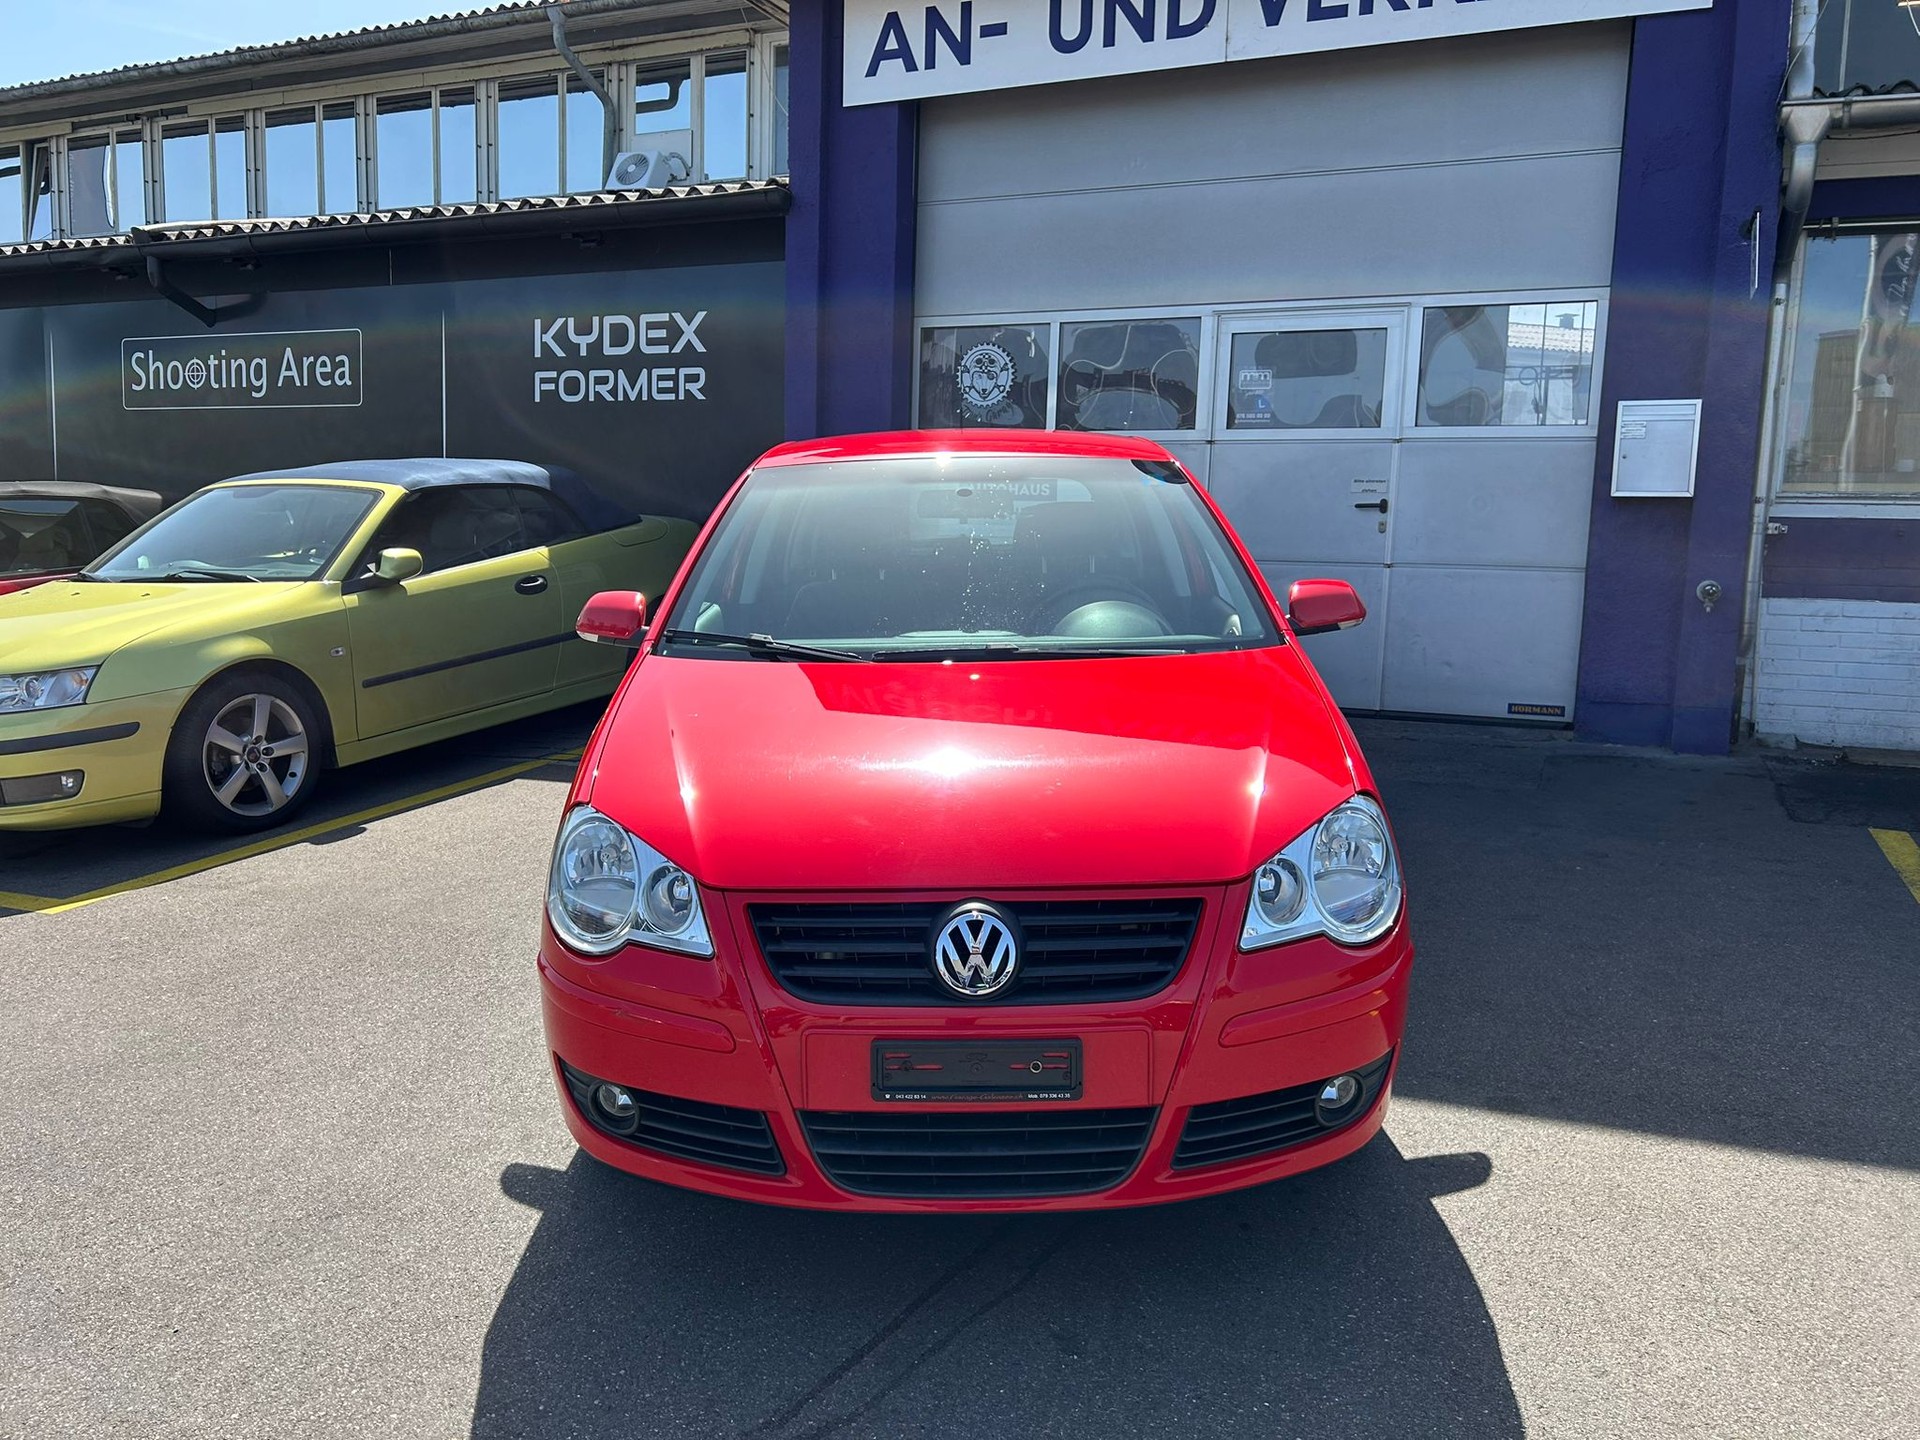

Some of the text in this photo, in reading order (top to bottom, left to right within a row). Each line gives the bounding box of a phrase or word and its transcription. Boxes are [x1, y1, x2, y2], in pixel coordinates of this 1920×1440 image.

[864, 1, 1008, 78] AN-
[1049, 0, 1217, 54] UND
[533, 311, 707, 358] KYDEX
[131, 346, 352, 398] Shooting Area
[533, 366, 707, 402] FORMER
